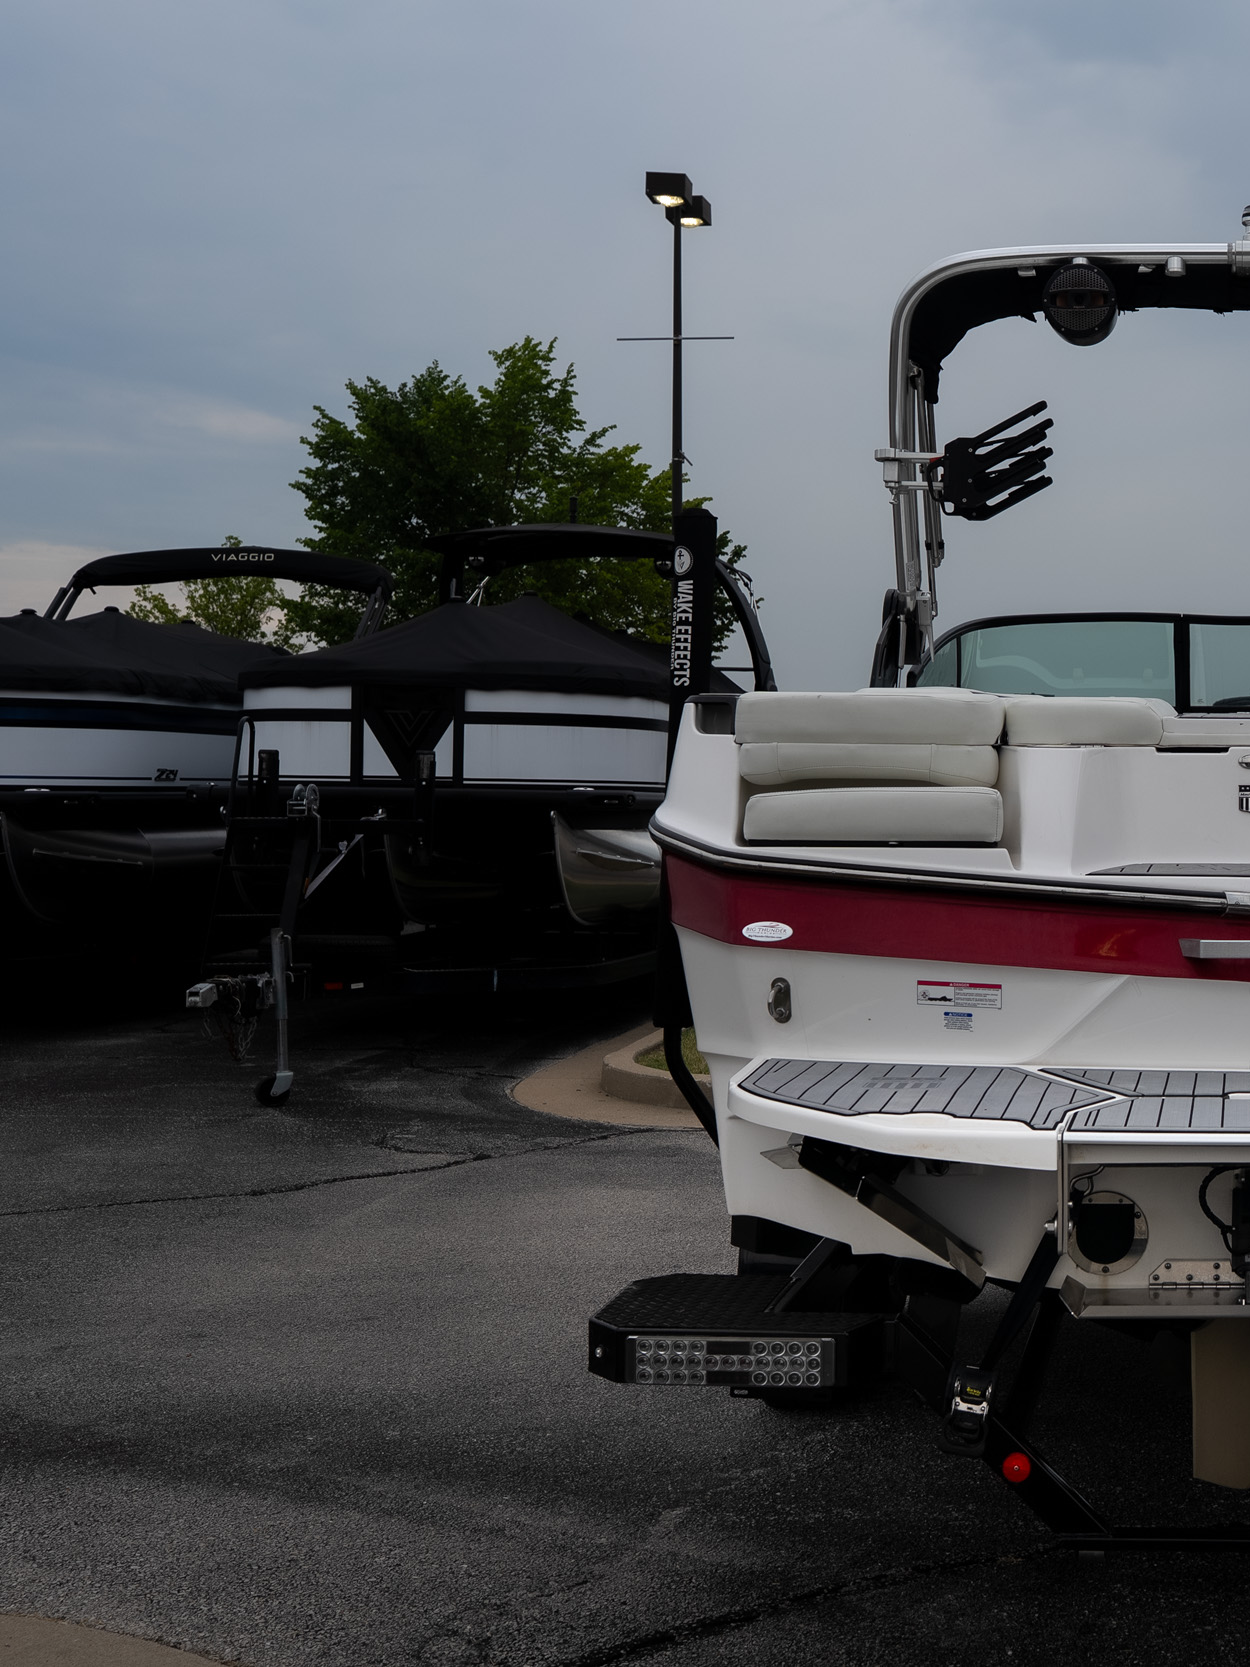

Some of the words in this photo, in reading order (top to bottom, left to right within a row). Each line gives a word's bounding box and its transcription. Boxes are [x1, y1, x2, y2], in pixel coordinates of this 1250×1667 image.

[211, 553, 275, 562] VIAGGIO
[677, 580, 694, 622] WAKE
[673, 625, 692, 687] EFFECTS
